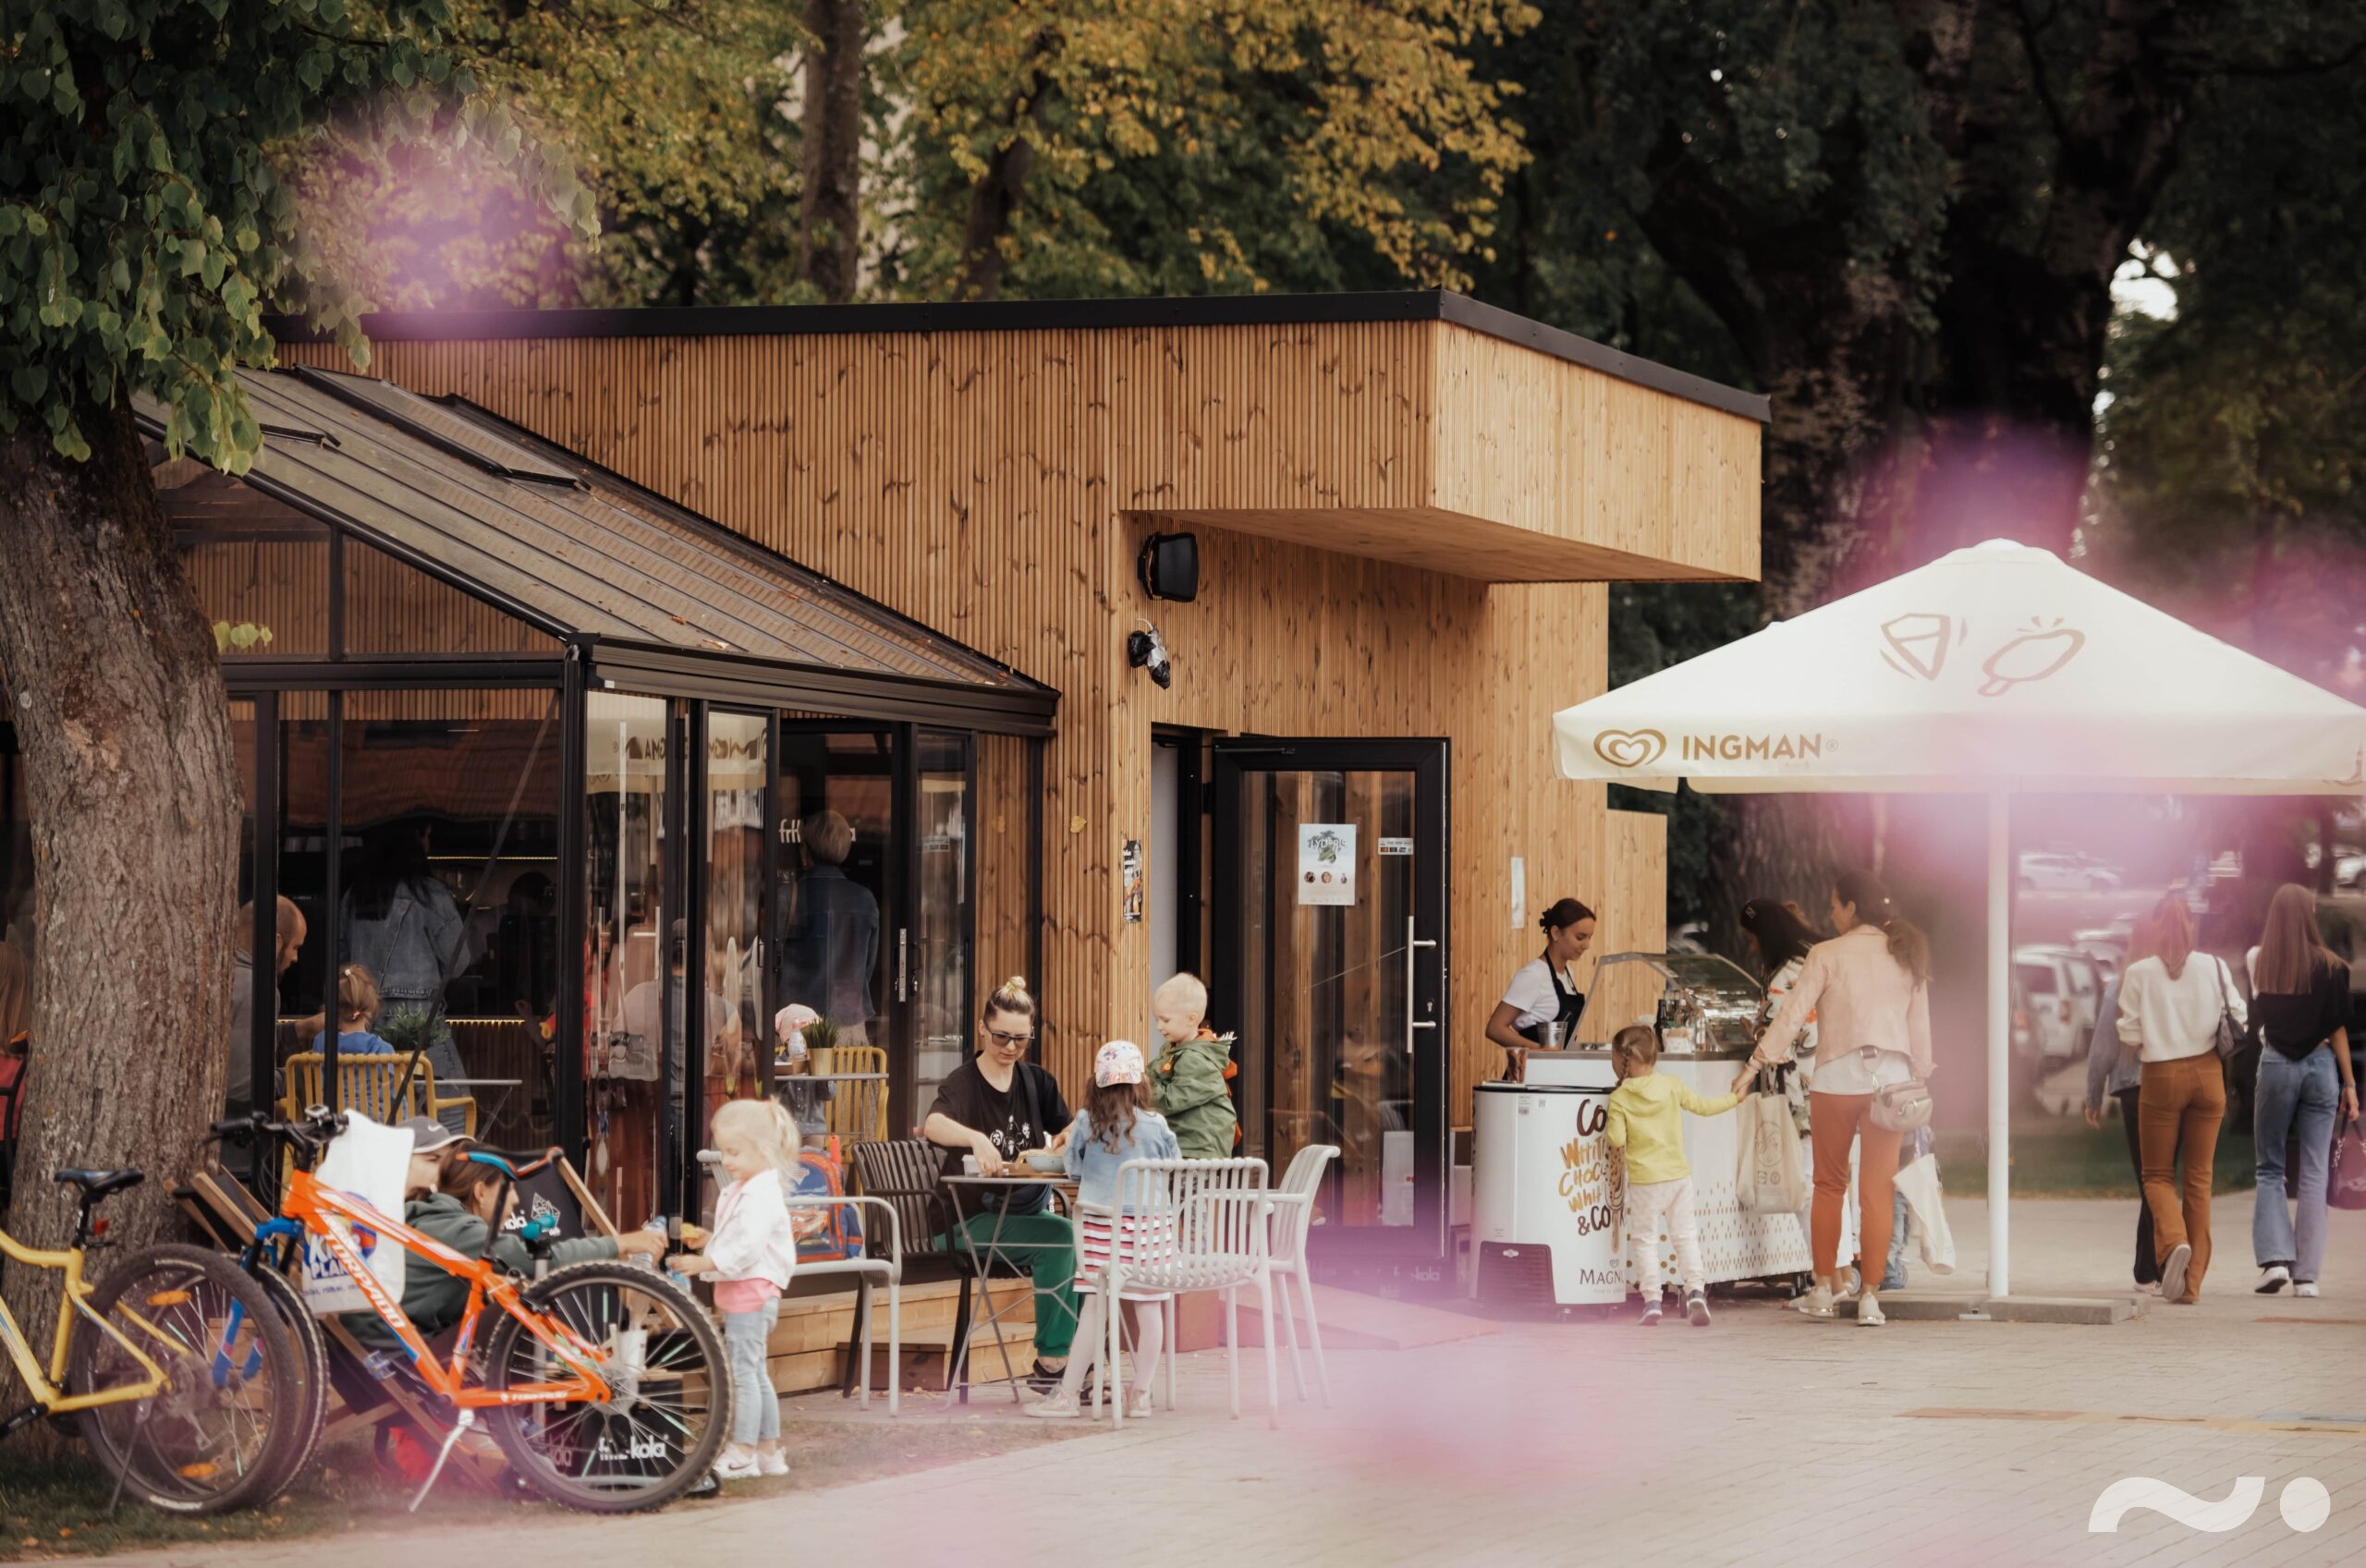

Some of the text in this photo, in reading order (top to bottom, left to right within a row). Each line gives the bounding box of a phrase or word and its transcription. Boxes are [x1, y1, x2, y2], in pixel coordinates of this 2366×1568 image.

[1683, 734, 1822, 760] INGMAN
[1559, 1162, 1604, 1197] CHOC
[1579, 1269, 1624, 1285] MAGN
